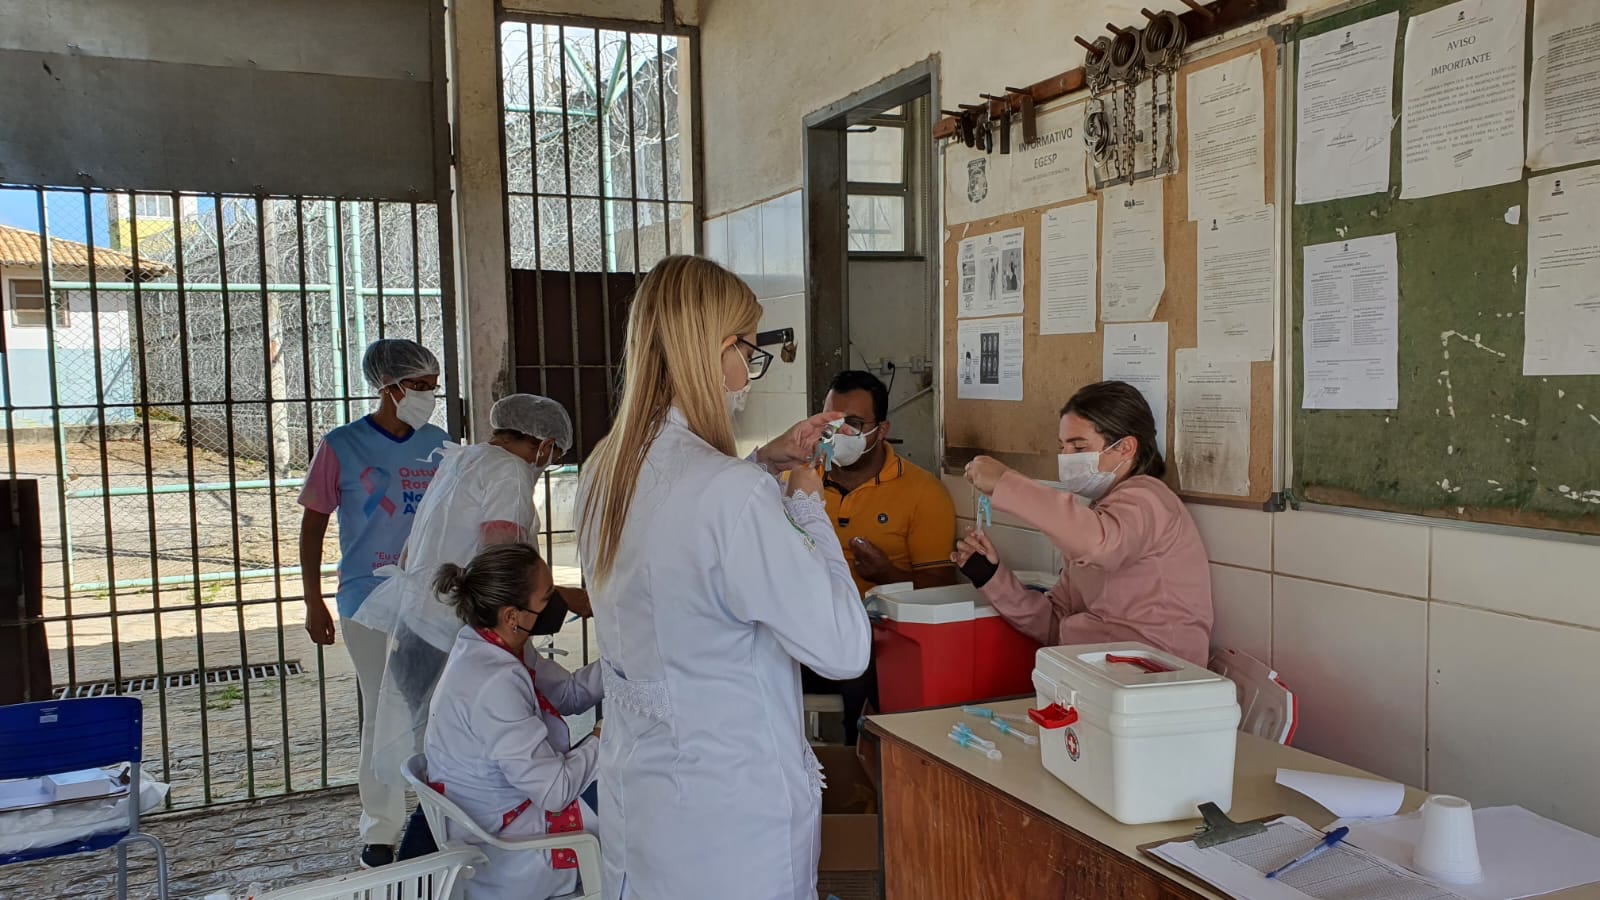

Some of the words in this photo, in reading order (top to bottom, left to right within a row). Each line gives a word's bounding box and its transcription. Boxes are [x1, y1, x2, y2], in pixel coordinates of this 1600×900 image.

[1446, 35, 1477, 52] AVISO
[1430, 52, 1492, 77] IMPORTANTE
[1034, 153, 1057, 168] EGESP
[402, 480, 429, 490] Ros
[403, 491, 424, 503] No
